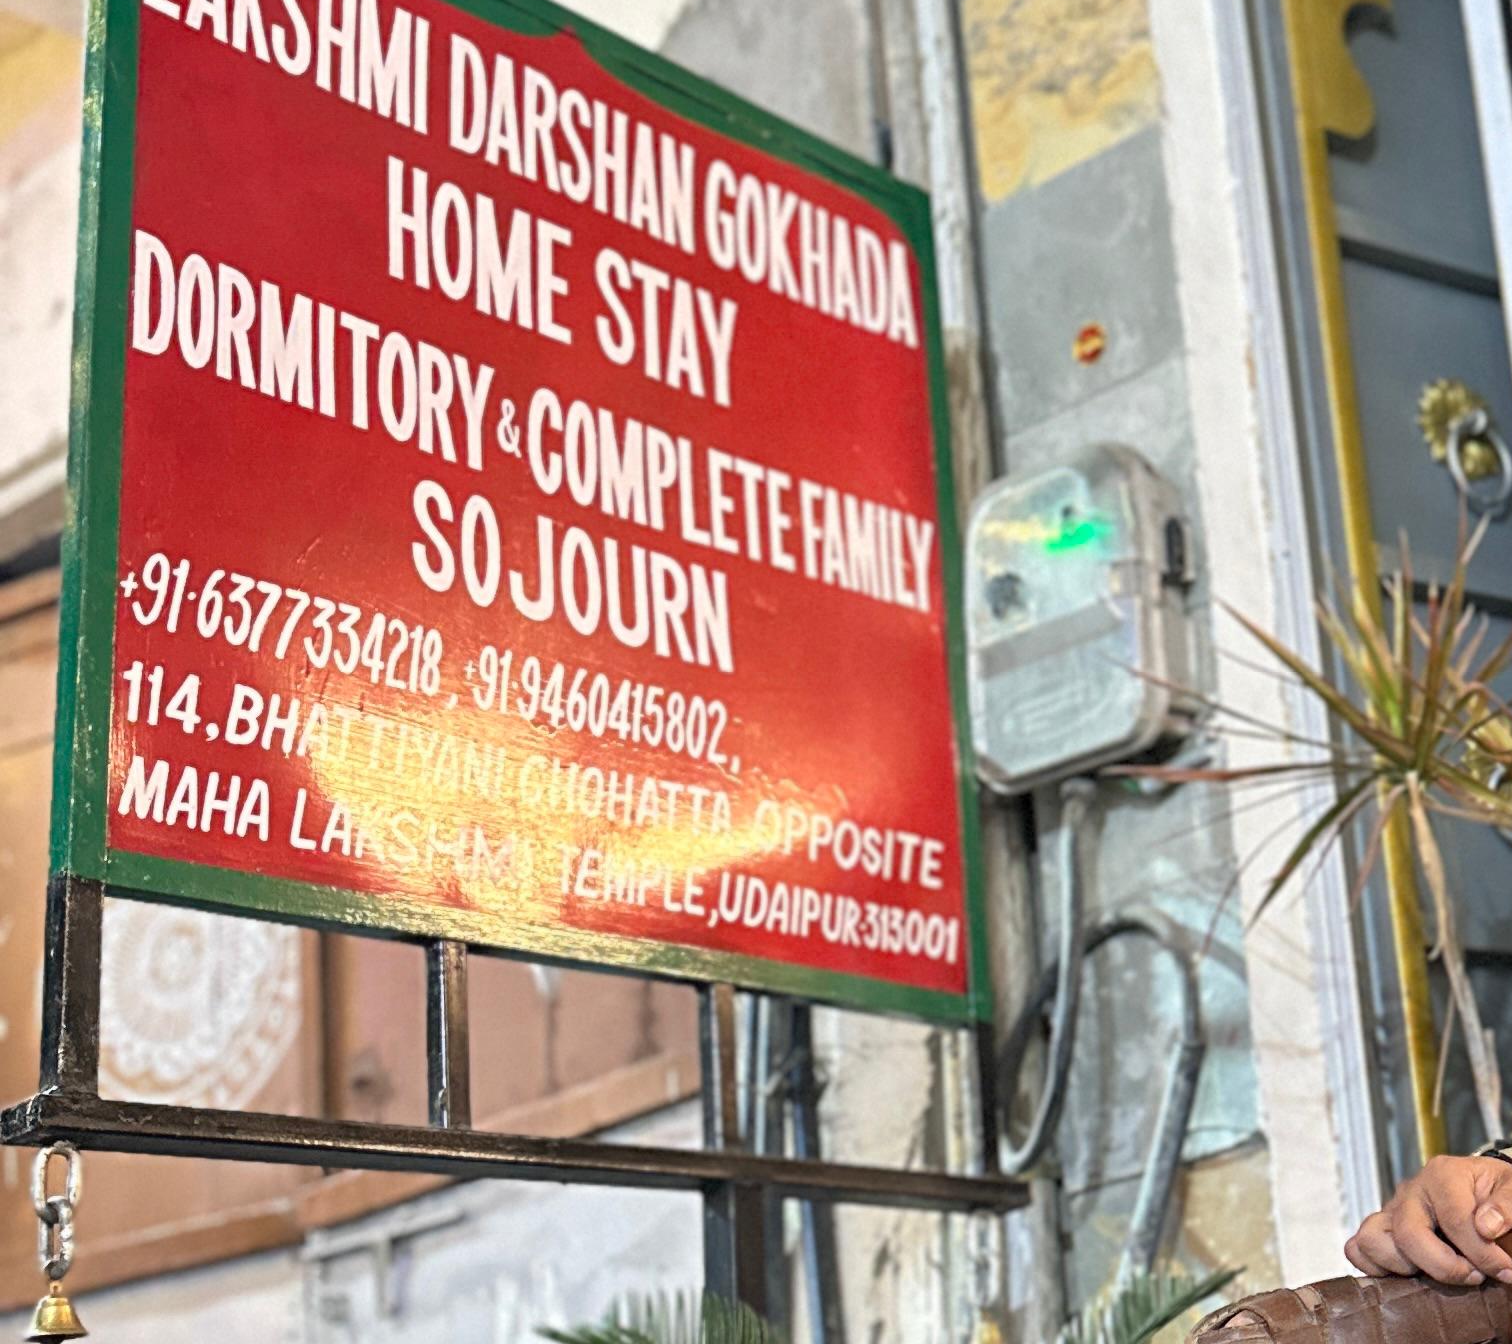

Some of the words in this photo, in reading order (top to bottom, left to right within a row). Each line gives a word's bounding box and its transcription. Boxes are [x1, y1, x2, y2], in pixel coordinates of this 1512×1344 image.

[388, 155, 572, 346] HOME
[594, 248, 738, 408] STAY
[450, 34, 696, 255] DARSHAN
[705, 160, 918, 349] GOKHADA
[132, 230, 495, 471] DORMITORY
[497, 398, 522, 458] &
[528, 388, 796, 573] COMPLETE
[800, 479, 935, 613] FAMILY
[412, 480, 735, 674] SOJOURN
[118, 755, 270, 842] MAHA
[290, 788, 536, 884] LAKSHMI
[754, 800, 946, 889] OPPOSITE
